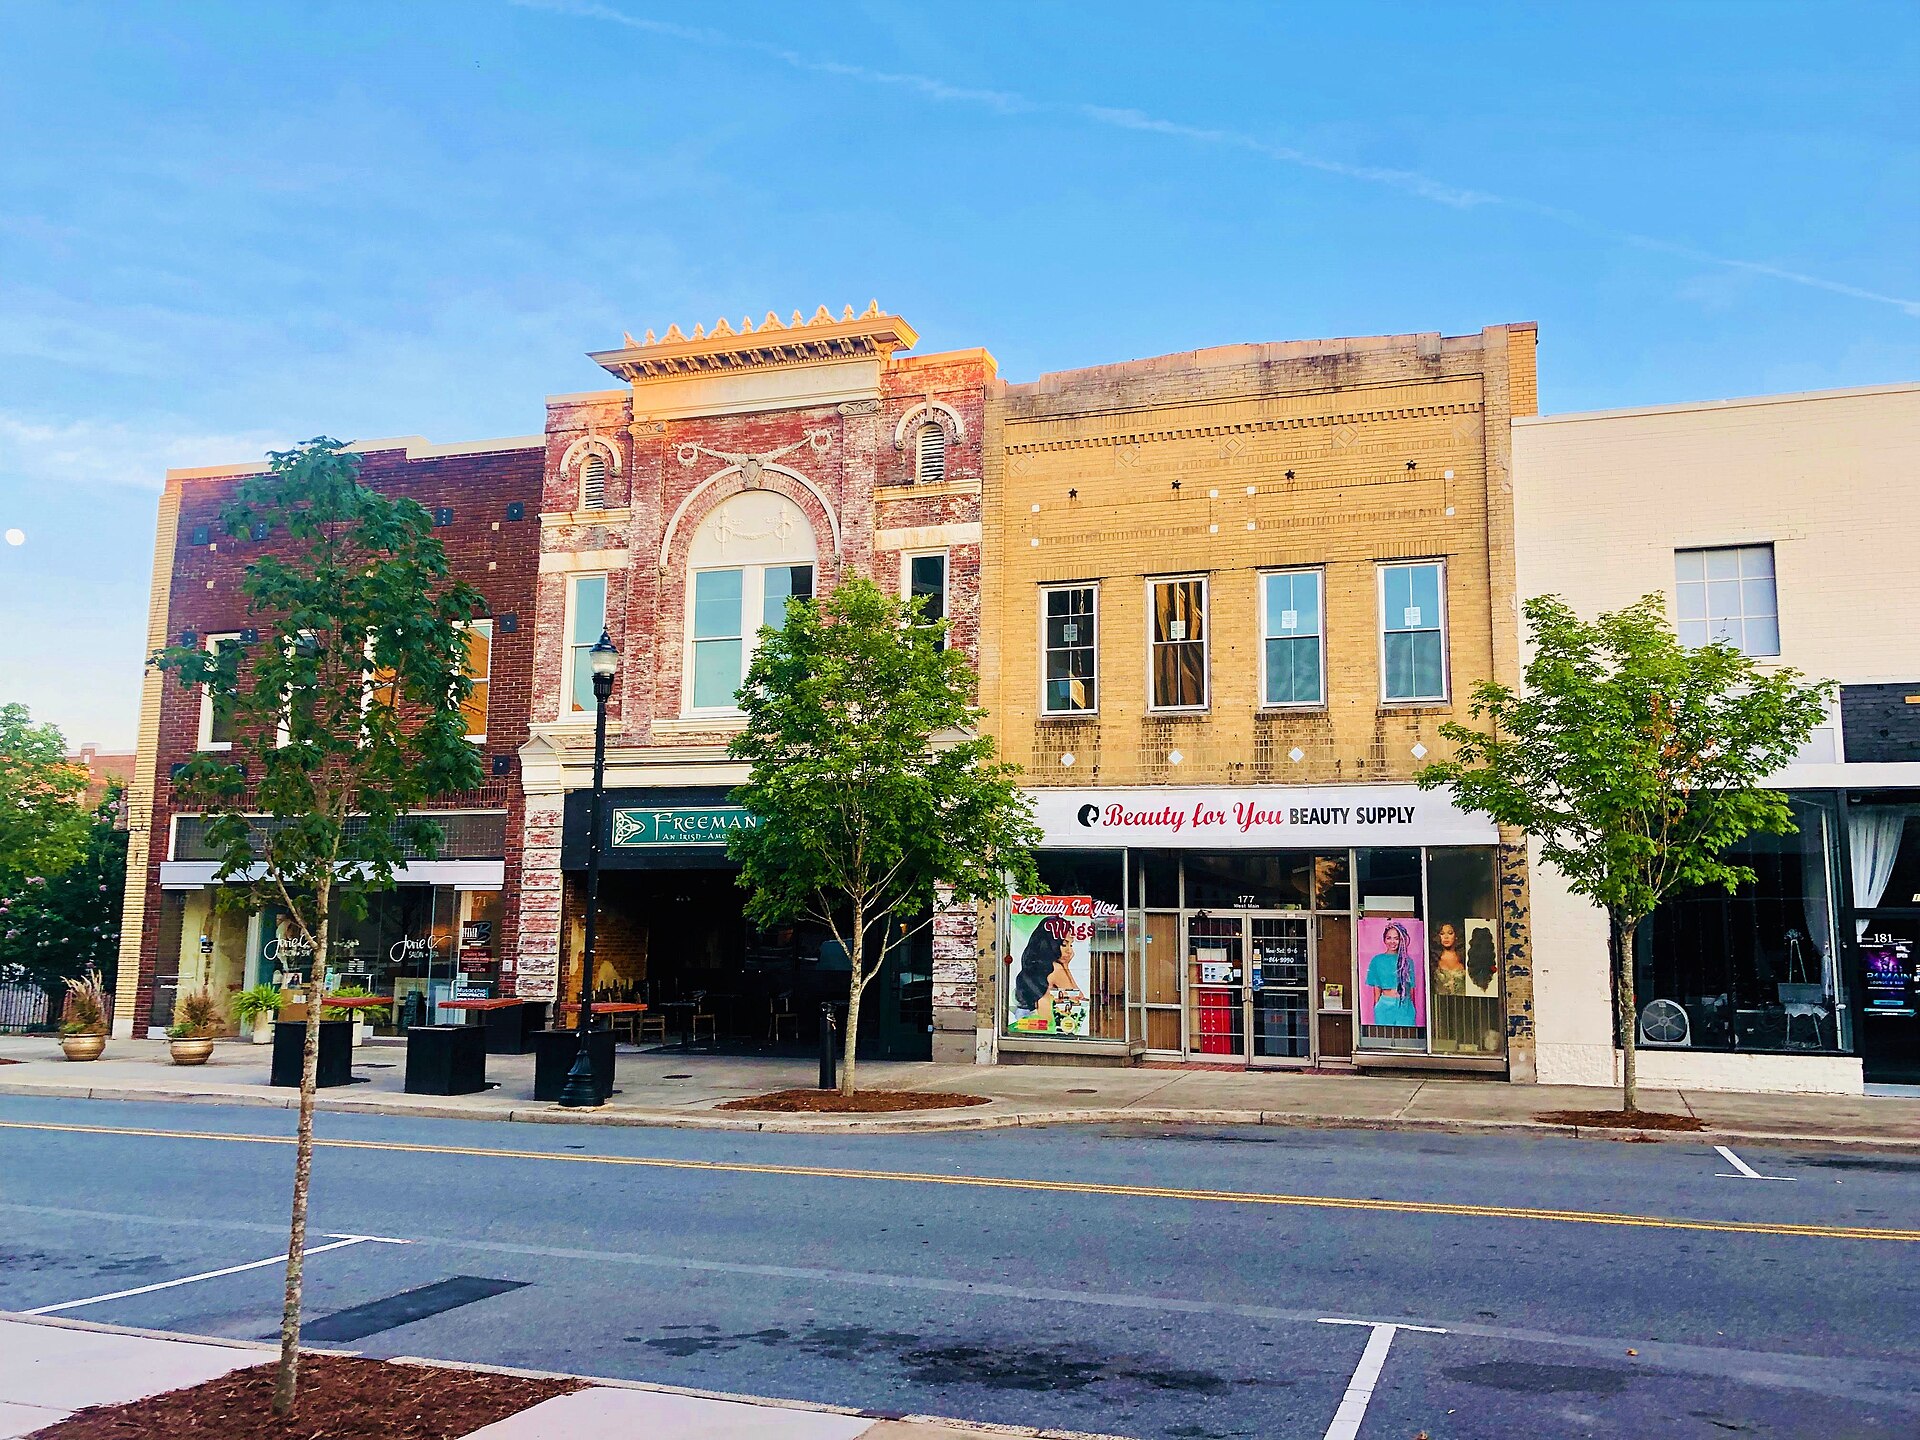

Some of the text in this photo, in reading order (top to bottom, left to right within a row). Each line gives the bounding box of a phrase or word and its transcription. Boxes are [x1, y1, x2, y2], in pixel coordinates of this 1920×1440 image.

[1103, 802, 1416, 833] Beauty for You BEAUTY SUPPLY
[653, 813, 758, 841] FREEMAN
[679, 833, 730, 842] IRISH-AME
[1013, 896, 1069, 917] Beauty
[1091, 900, 1119, 919] You
[1237, 895, 1255, 903] 177
[1045, 920, 1096, 941] Wigs
[1874, 934, 1893, 943] 181
[427, 934, 453, 949] C.
